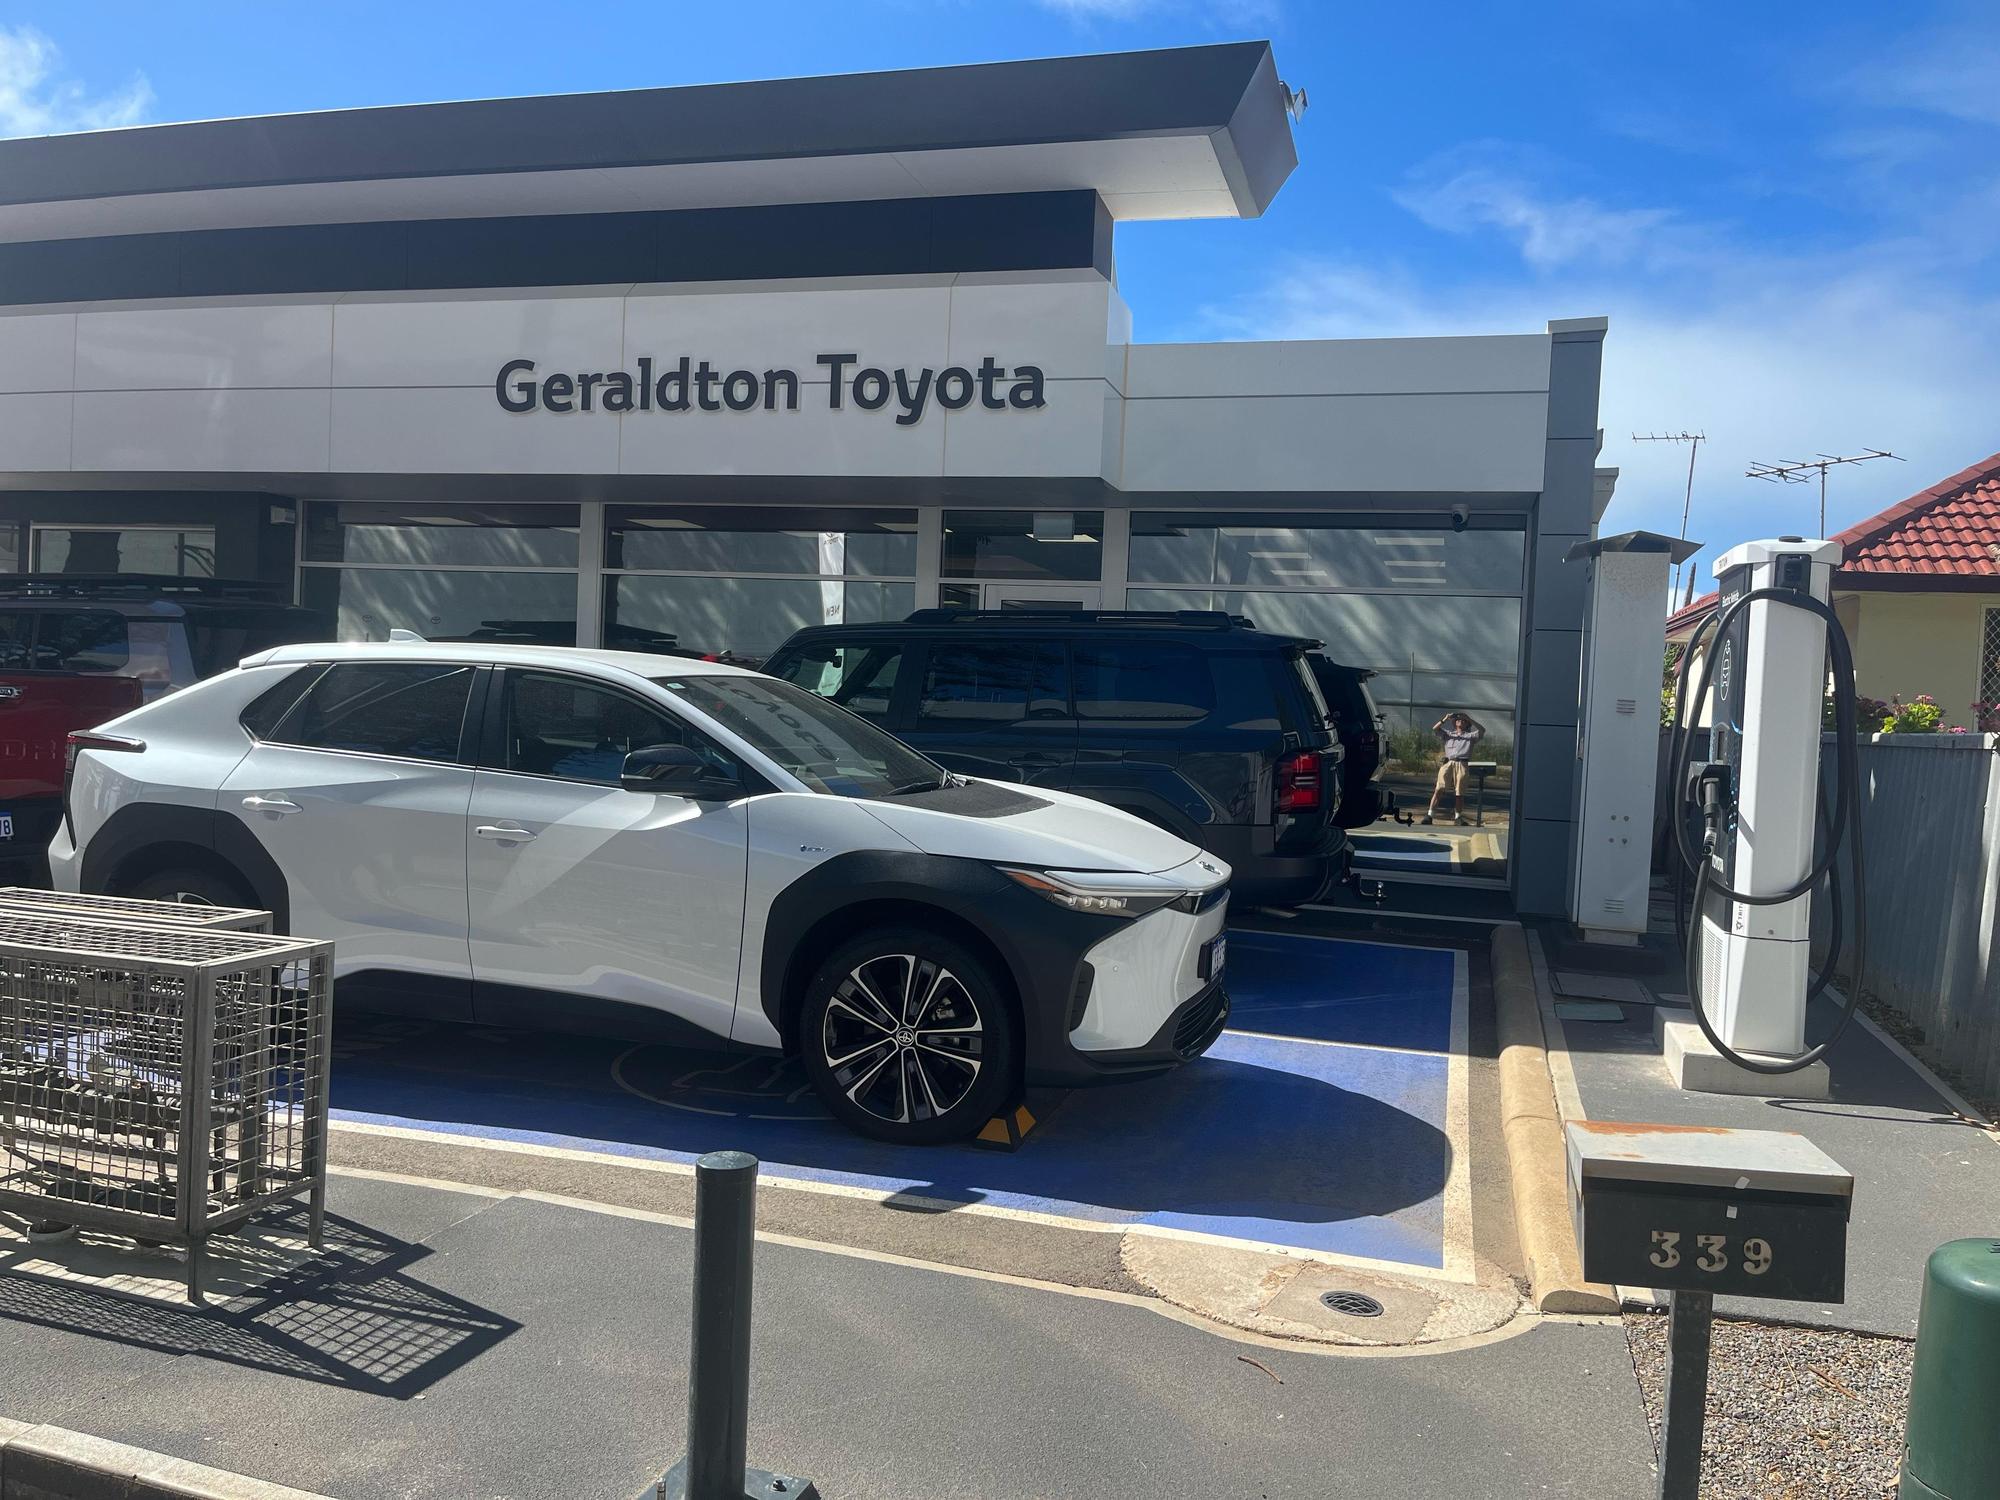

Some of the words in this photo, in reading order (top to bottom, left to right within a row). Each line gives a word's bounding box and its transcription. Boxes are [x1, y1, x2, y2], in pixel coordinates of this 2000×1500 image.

[495, 357, 799, 413] Geraldton
[816, 353, 1048, 426] Toyota
[1650, 1230, 1773, 1275] 339
